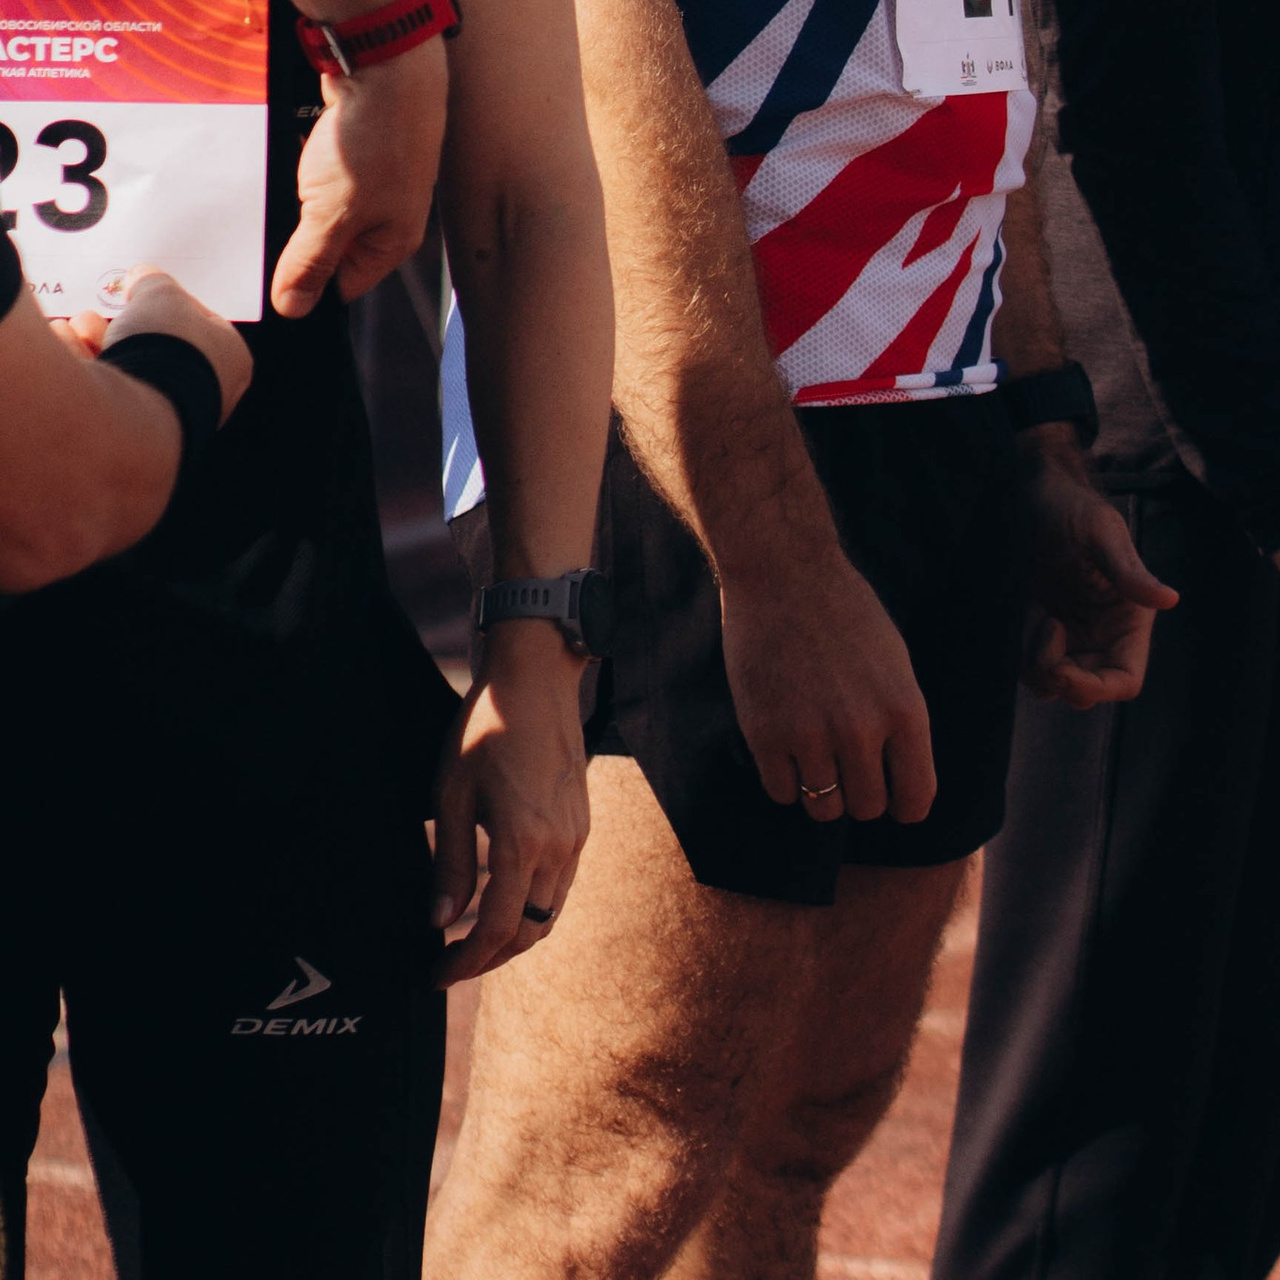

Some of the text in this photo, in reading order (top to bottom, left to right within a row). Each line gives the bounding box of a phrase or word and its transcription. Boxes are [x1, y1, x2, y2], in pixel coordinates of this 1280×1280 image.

[103, 21, 163, 32] ОБЛАСТИ
[28, 67, 91, 79] АТЛЕТИКА
[231, 1016, 364, 1035] DEMIX
